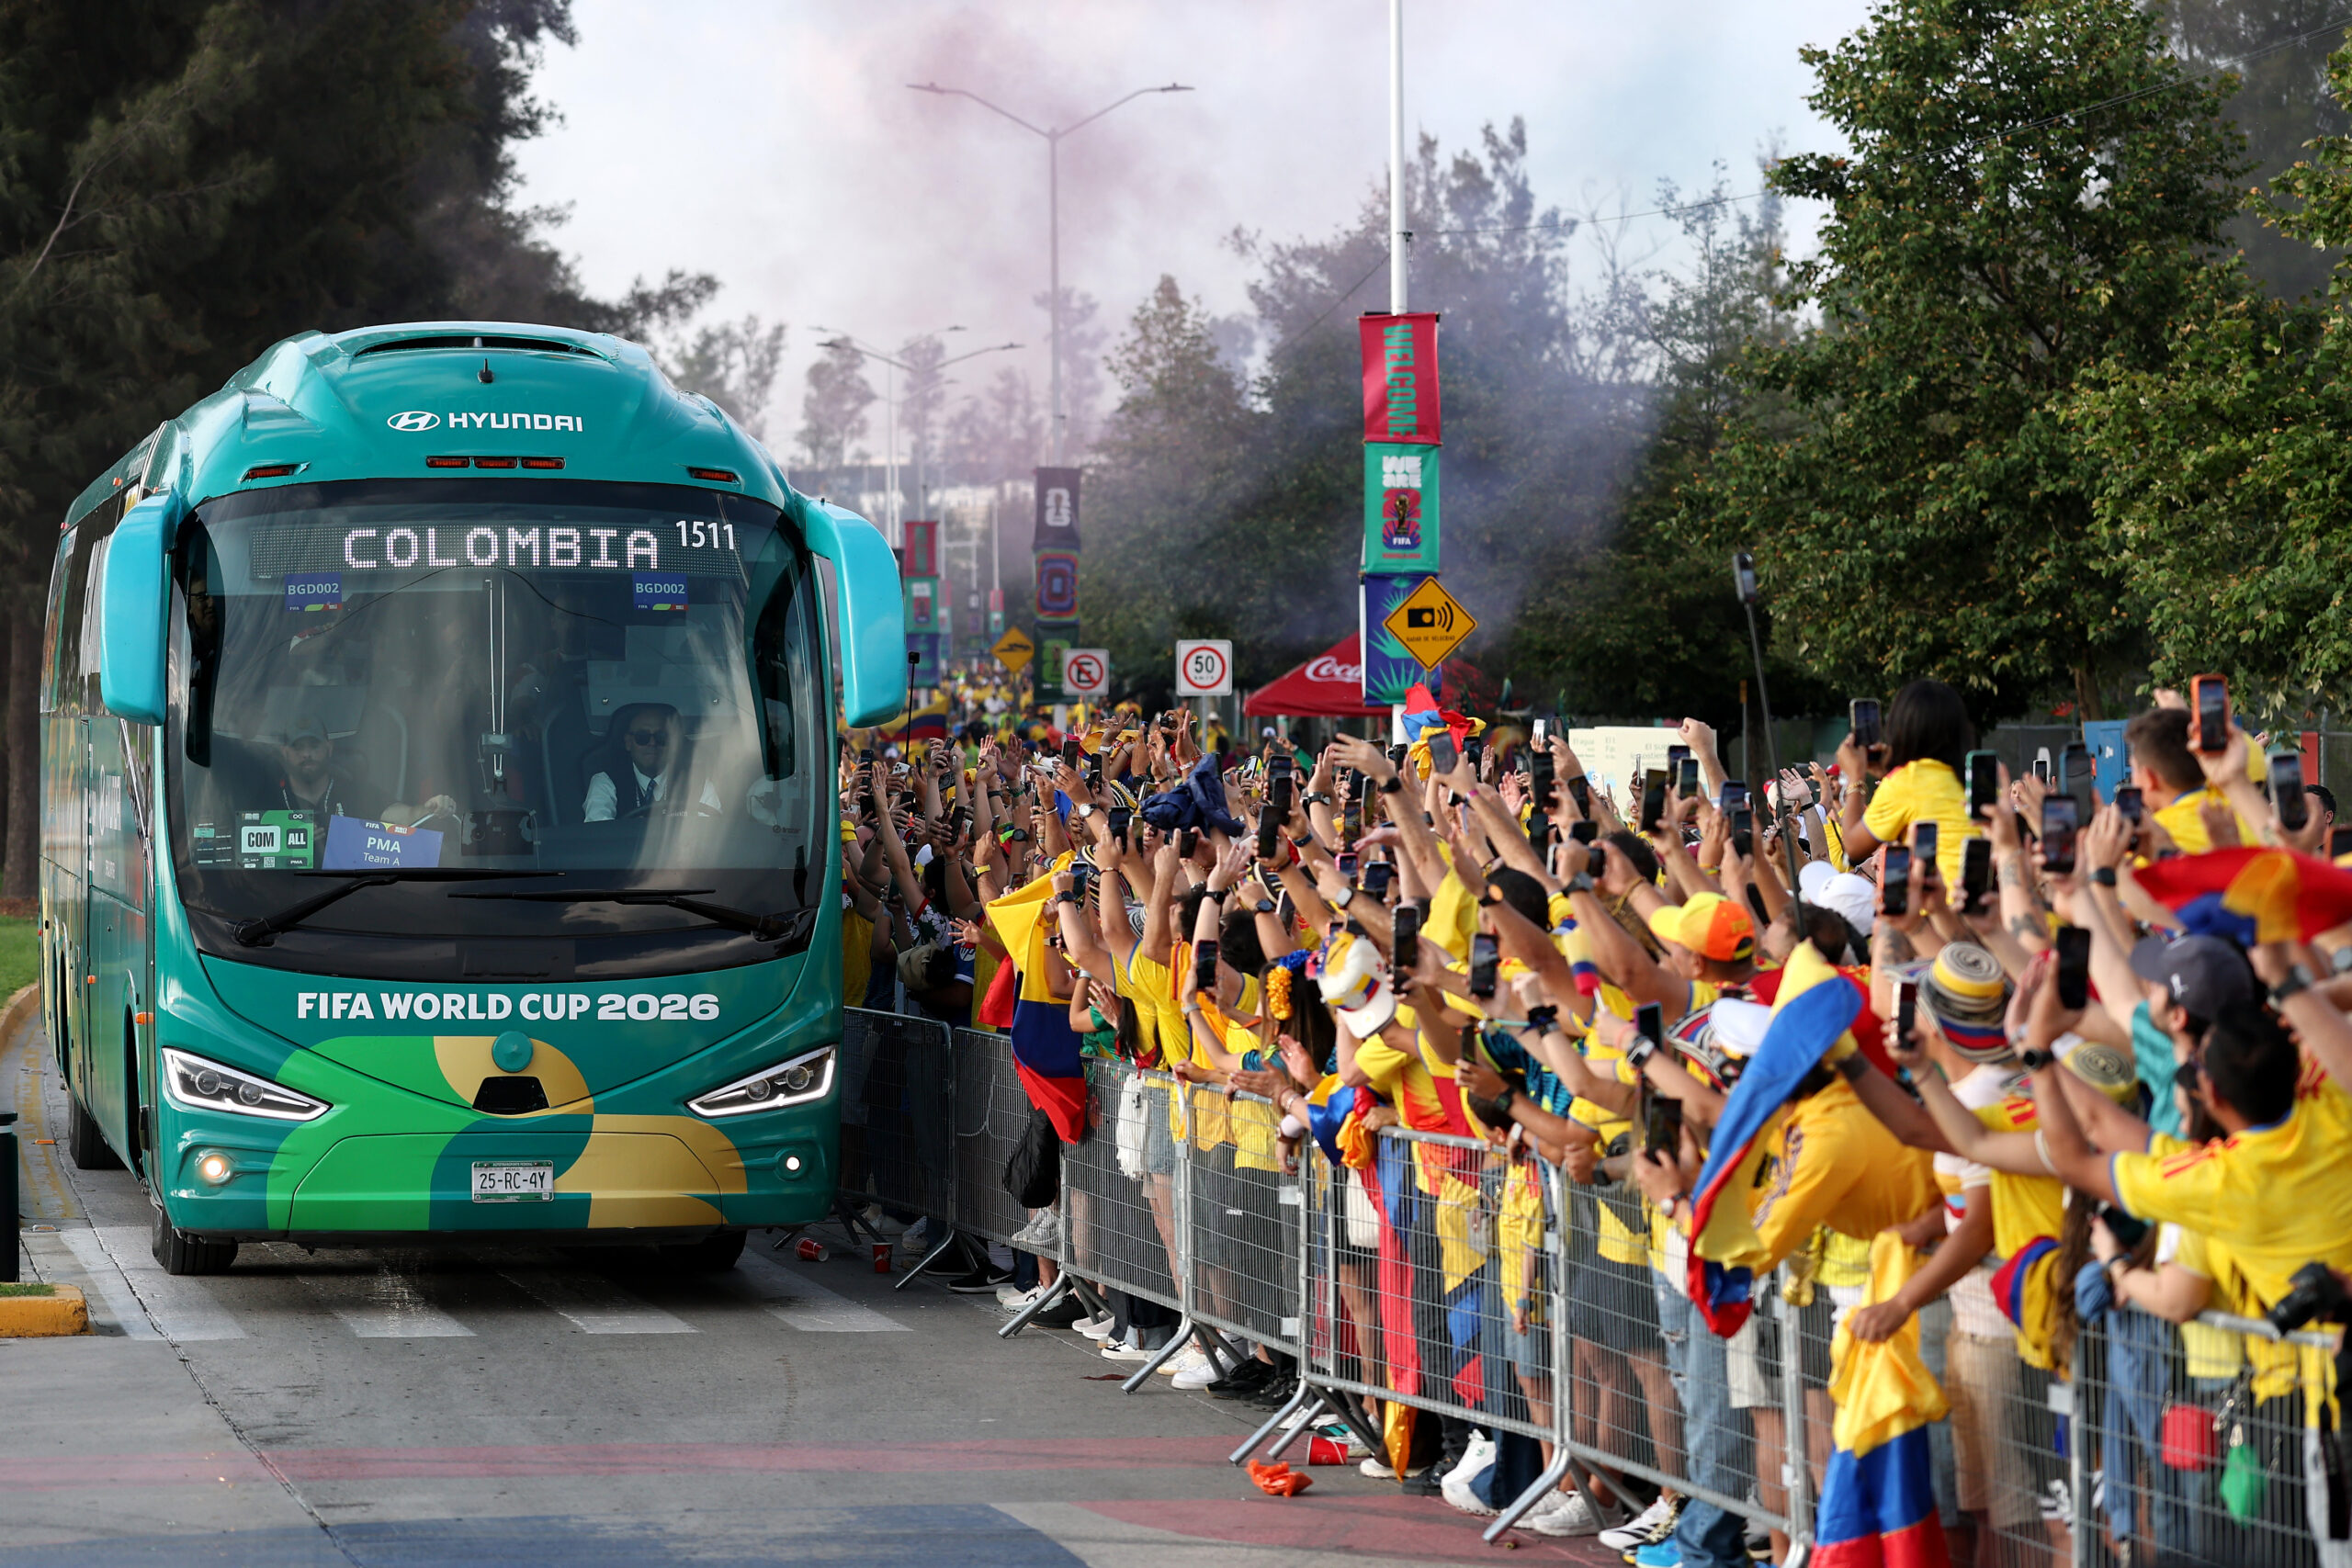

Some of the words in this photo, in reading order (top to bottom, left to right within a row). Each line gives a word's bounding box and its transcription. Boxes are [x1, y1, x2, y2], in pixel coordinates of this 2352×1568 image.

[1383, 323, 1417, 437] WELCOME
[448, 412, 583, 433] HYUNDAI
[1382, 456, 1422, 473] WE
[675, 520, 735, 550] 1511
[1393, 536, 1411, 546] FIFA
[345, 526, 659, 570] COLOMBIA
[288, 582, 339, 595] BGD002
[635, 582, 685, 594] BGD002
[1194, 655, 1215, 673] 50
[247, 831, 275, 848] COM
[288, 832, 307, 845] ALL
[367, 837, 401, 853] PMA
[363, 852, 390, 864] Team
[392, 857, 401, 866] A
[298, 992, 375, 1020] FIFA
[379, 992, 512, 1021] WORLD
[519, 993, 591, 1021] CUP
[597, 993, 720, 1021] 2026
[480, 1171, 546, 1190] 25-RC-4Y
